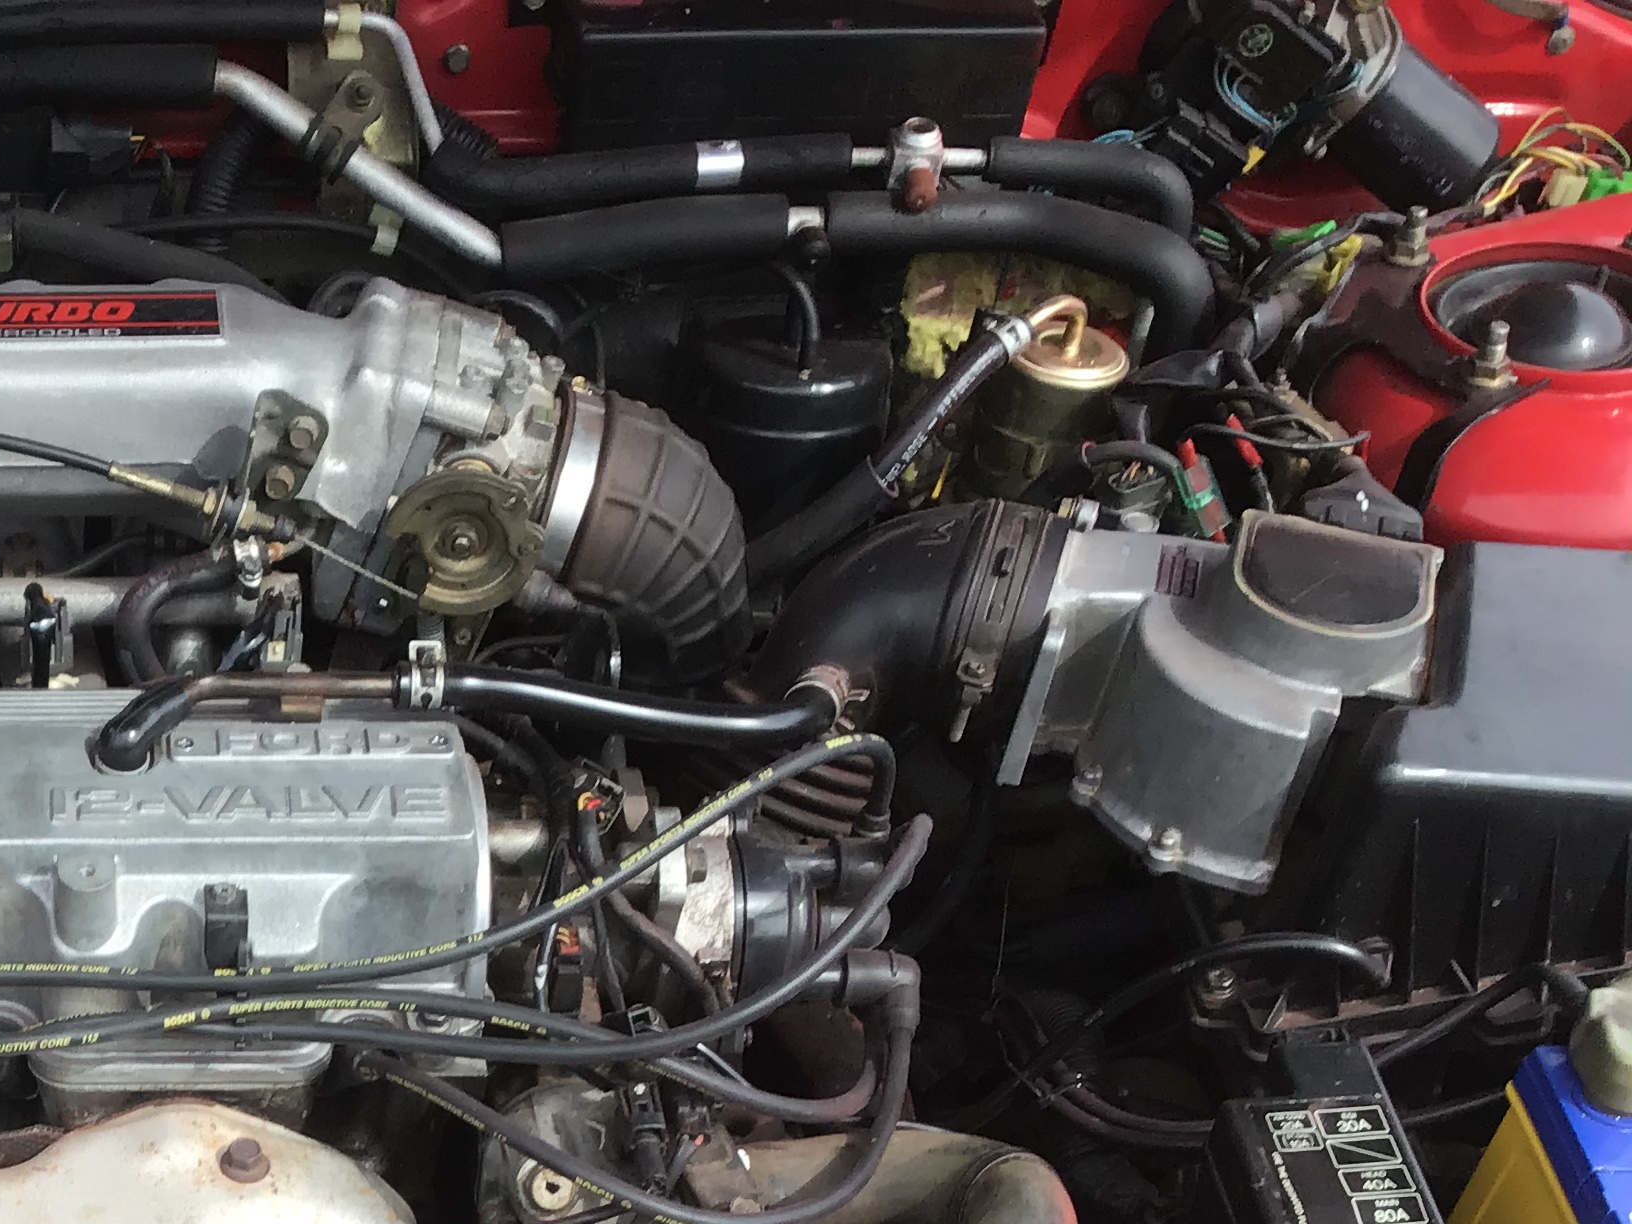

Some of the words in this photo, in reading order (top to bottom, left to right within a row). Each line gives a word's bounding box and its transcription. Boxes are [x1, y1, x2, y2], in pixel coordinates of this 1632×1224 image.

[216, 728, 412, 756] FORD
[48, 784, 449, 824] 12-VALVE
[214, 968, 254, 977] BOSH
[292, 962, 328, 974] SUPER
[372, 947, 428, 965] INDUCTIVE
[163, 1011, 196, 1029] BOSCH
[228, 1003, 263, 1016] SUPER
[263, 1000, 304, 1012] SPORTS
[39, 1036, 72, 1050] CORE
[1362, 1177, 1398, 1191] 40A
[1373, 1207, 1410, 1223] 80A
